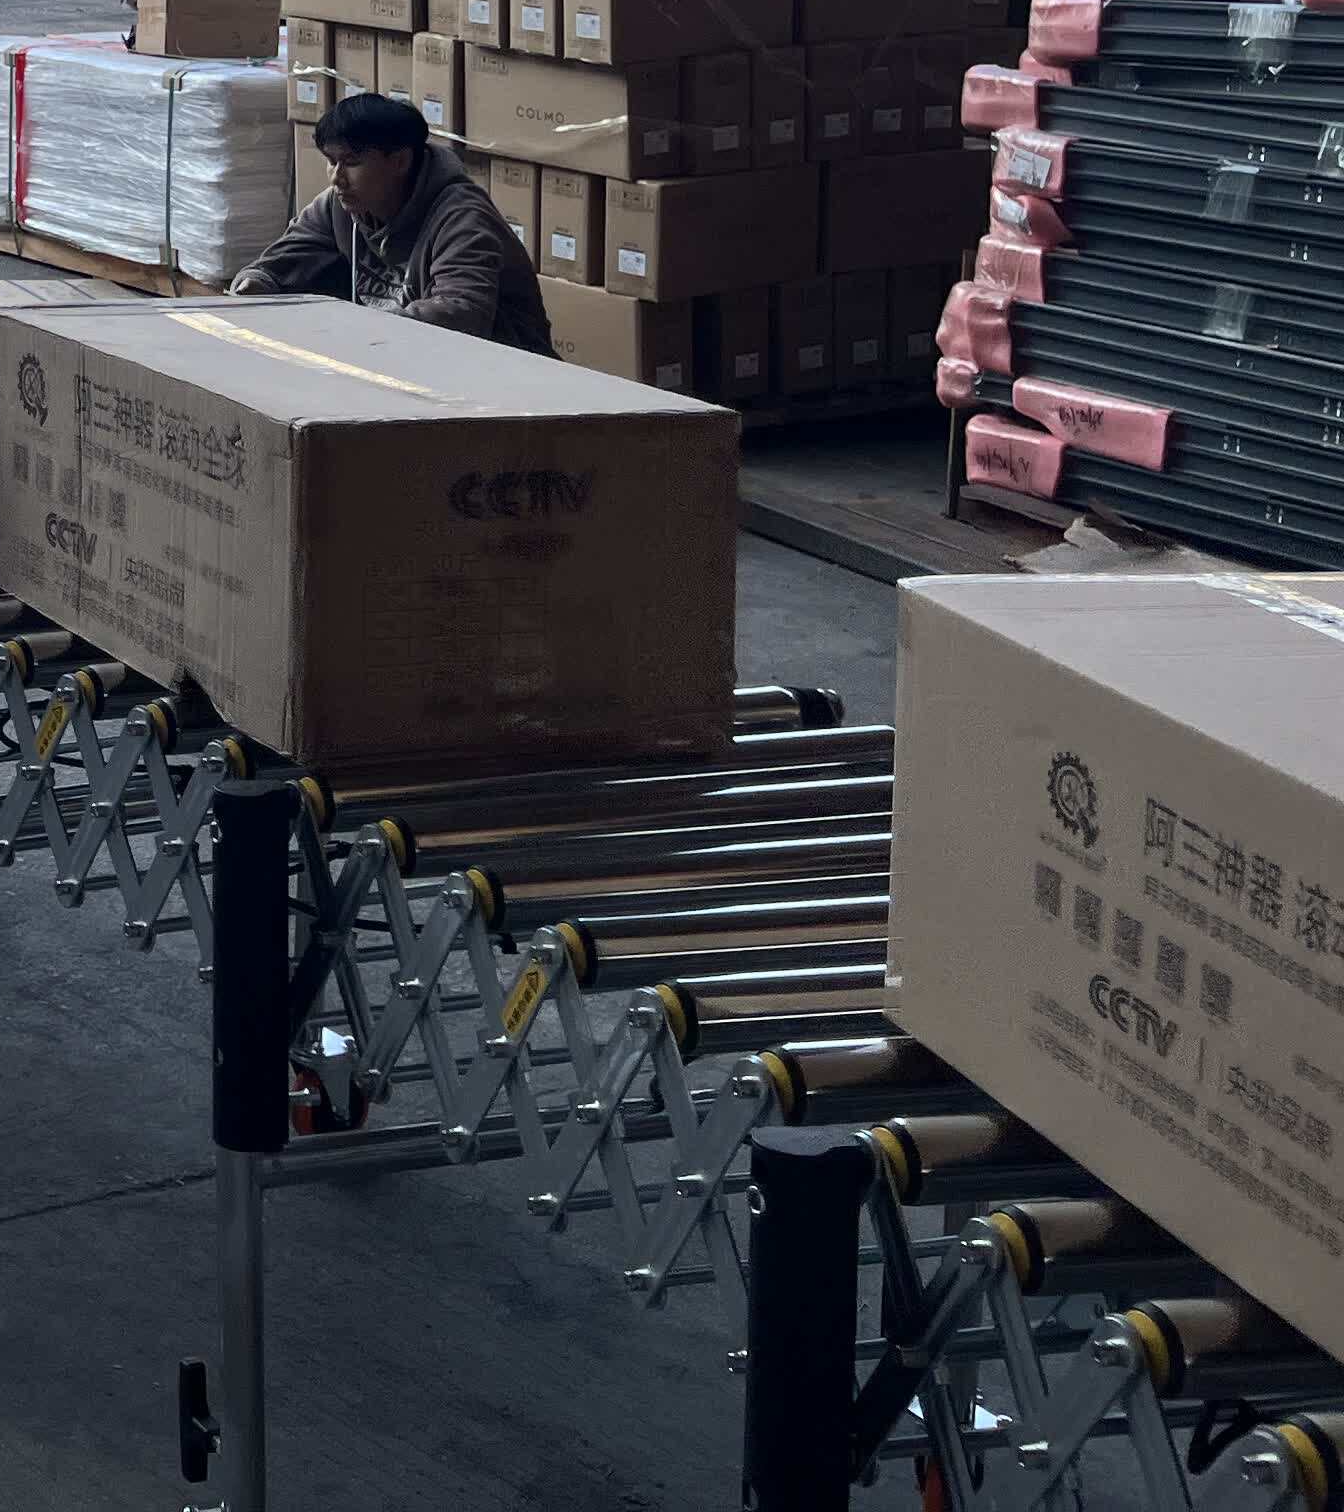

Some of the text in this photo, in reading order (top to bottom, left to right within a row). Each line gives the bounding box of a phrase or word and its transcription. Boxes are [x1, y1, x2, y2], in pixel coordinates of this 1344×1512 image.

[515, 105, 565, 124] COLMO
[446, 468, 597, 521] CCTV
[44, 510, 97, 565] CCTV
[1143, 796, 1283, 930] 阿三神器
[1088, 973, 1178, 1058] CCTV
